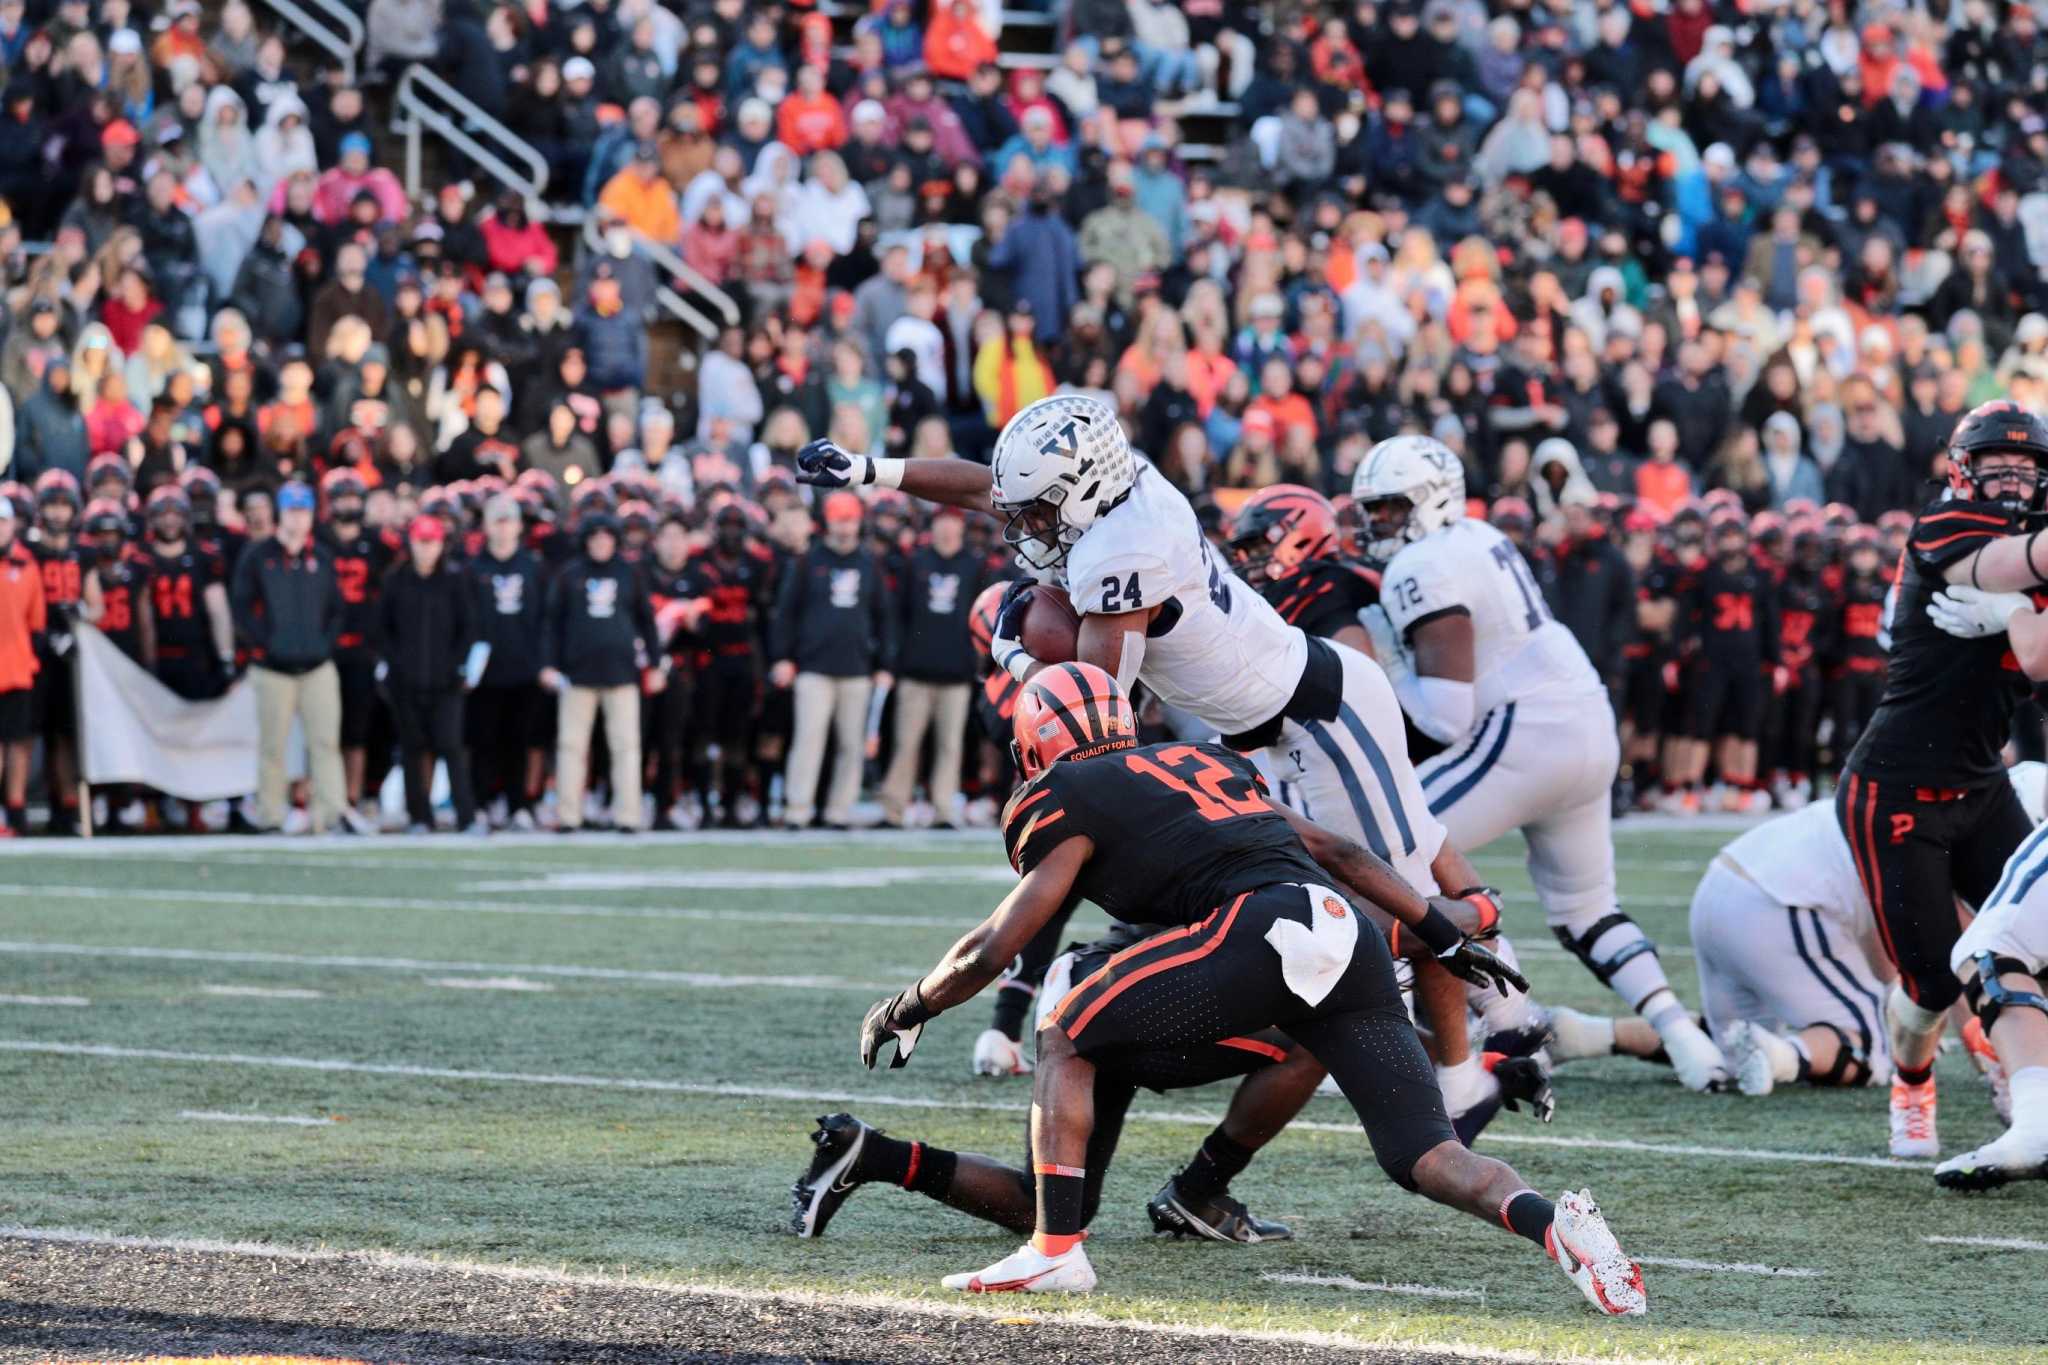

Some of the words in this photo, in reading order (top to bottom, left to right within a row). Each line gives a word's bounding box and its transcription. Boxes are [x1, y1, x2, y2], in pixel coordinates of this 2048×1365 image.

[1102, 572, 1142, 612] 24
[1392, 577, 1423, 612] 72
[1070, 743, 1110, 761] EQUALITY
[1111, 741, 1126, 751] FOR
[1288, 749, 1305, 772] Y
[1125, 745, 1274, 821] 12
[1889, 813, 1915, 844] P
